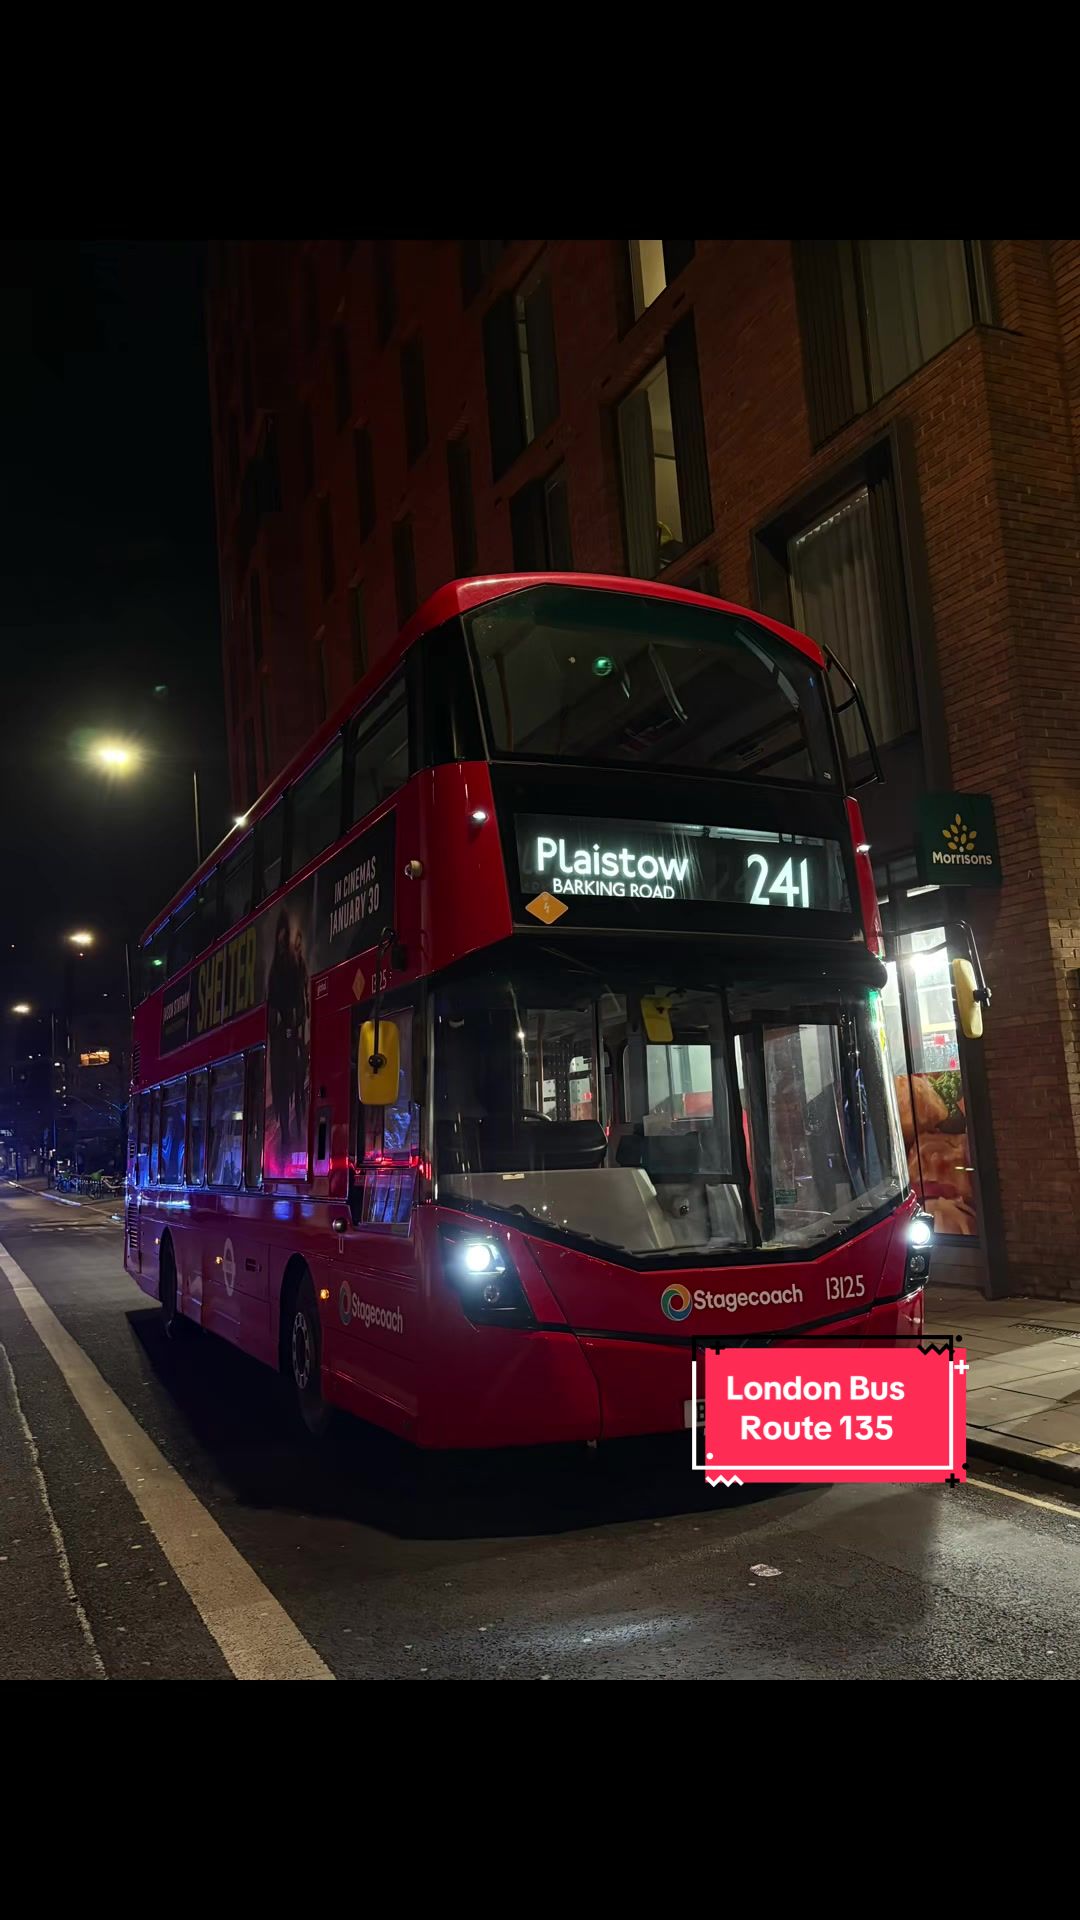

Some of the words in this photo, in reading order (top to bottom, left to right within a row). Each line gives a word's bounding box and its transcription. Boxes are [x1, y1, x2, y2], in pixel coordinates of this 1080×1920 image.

[334, 879, 343, 904] IN
[344, 855, 377, 898] CINEMAS
[536, 836, 689, 881] Plaistow
[932, 851, 993, 865] Morrisons
[552, 877, 627, 897] BARKING
[630, 883, 675, 900] ROAD
[747, 853, 810, 909] 241
[329, 891, 367, 944] JANUARY
[368, 883, 380, 914] 30
[197, 927, 257, 1033] SHELTER
[693, 1283, 804, 1312] Stagecoach
[826, 1275, 866, 1300] 13125
[352, 1292, 403, 1334] Stagecoach
